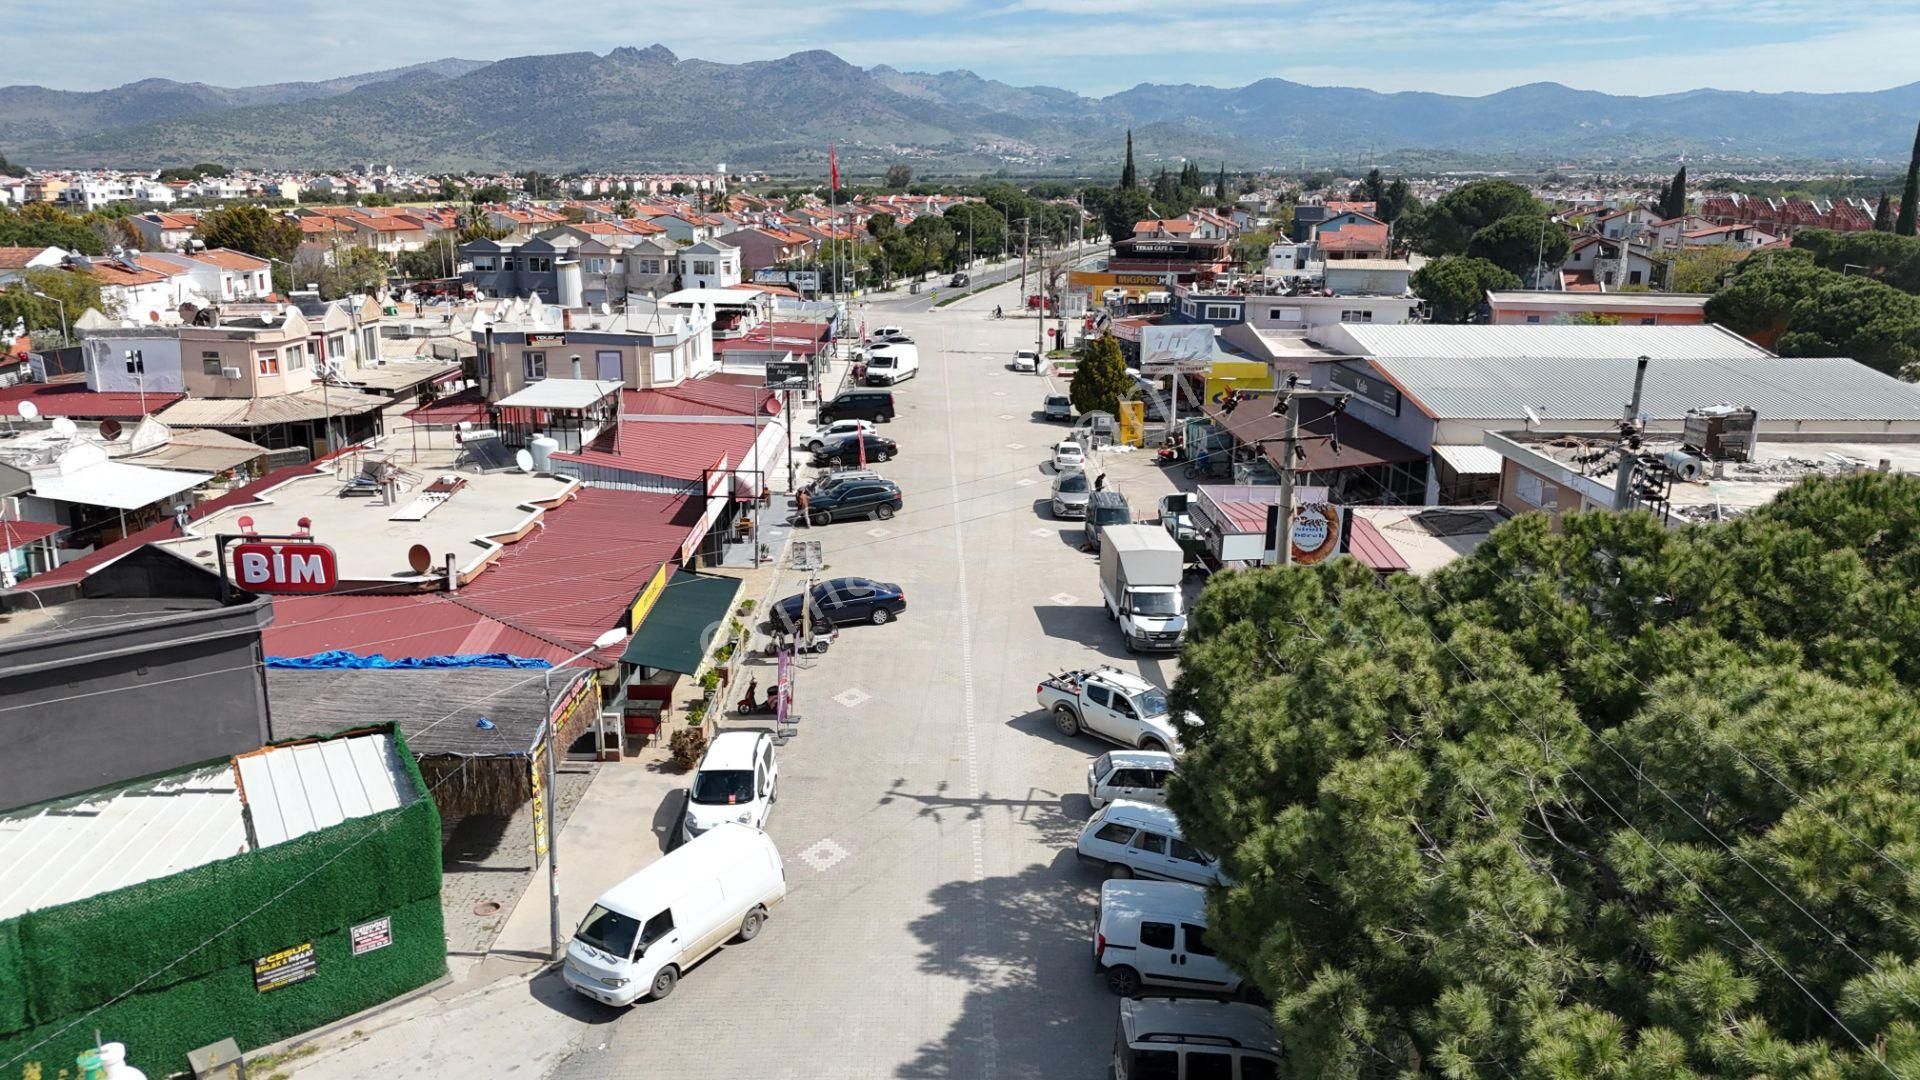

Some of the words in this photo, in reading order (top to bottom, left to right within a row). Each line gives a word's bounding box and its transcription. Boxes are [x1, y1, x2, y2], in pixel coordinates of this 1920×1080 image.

[242, 546, 326, 584] BİM
[266, 943, 312, 962] CESUR
[255, 960, 281, 974] EMLAK
